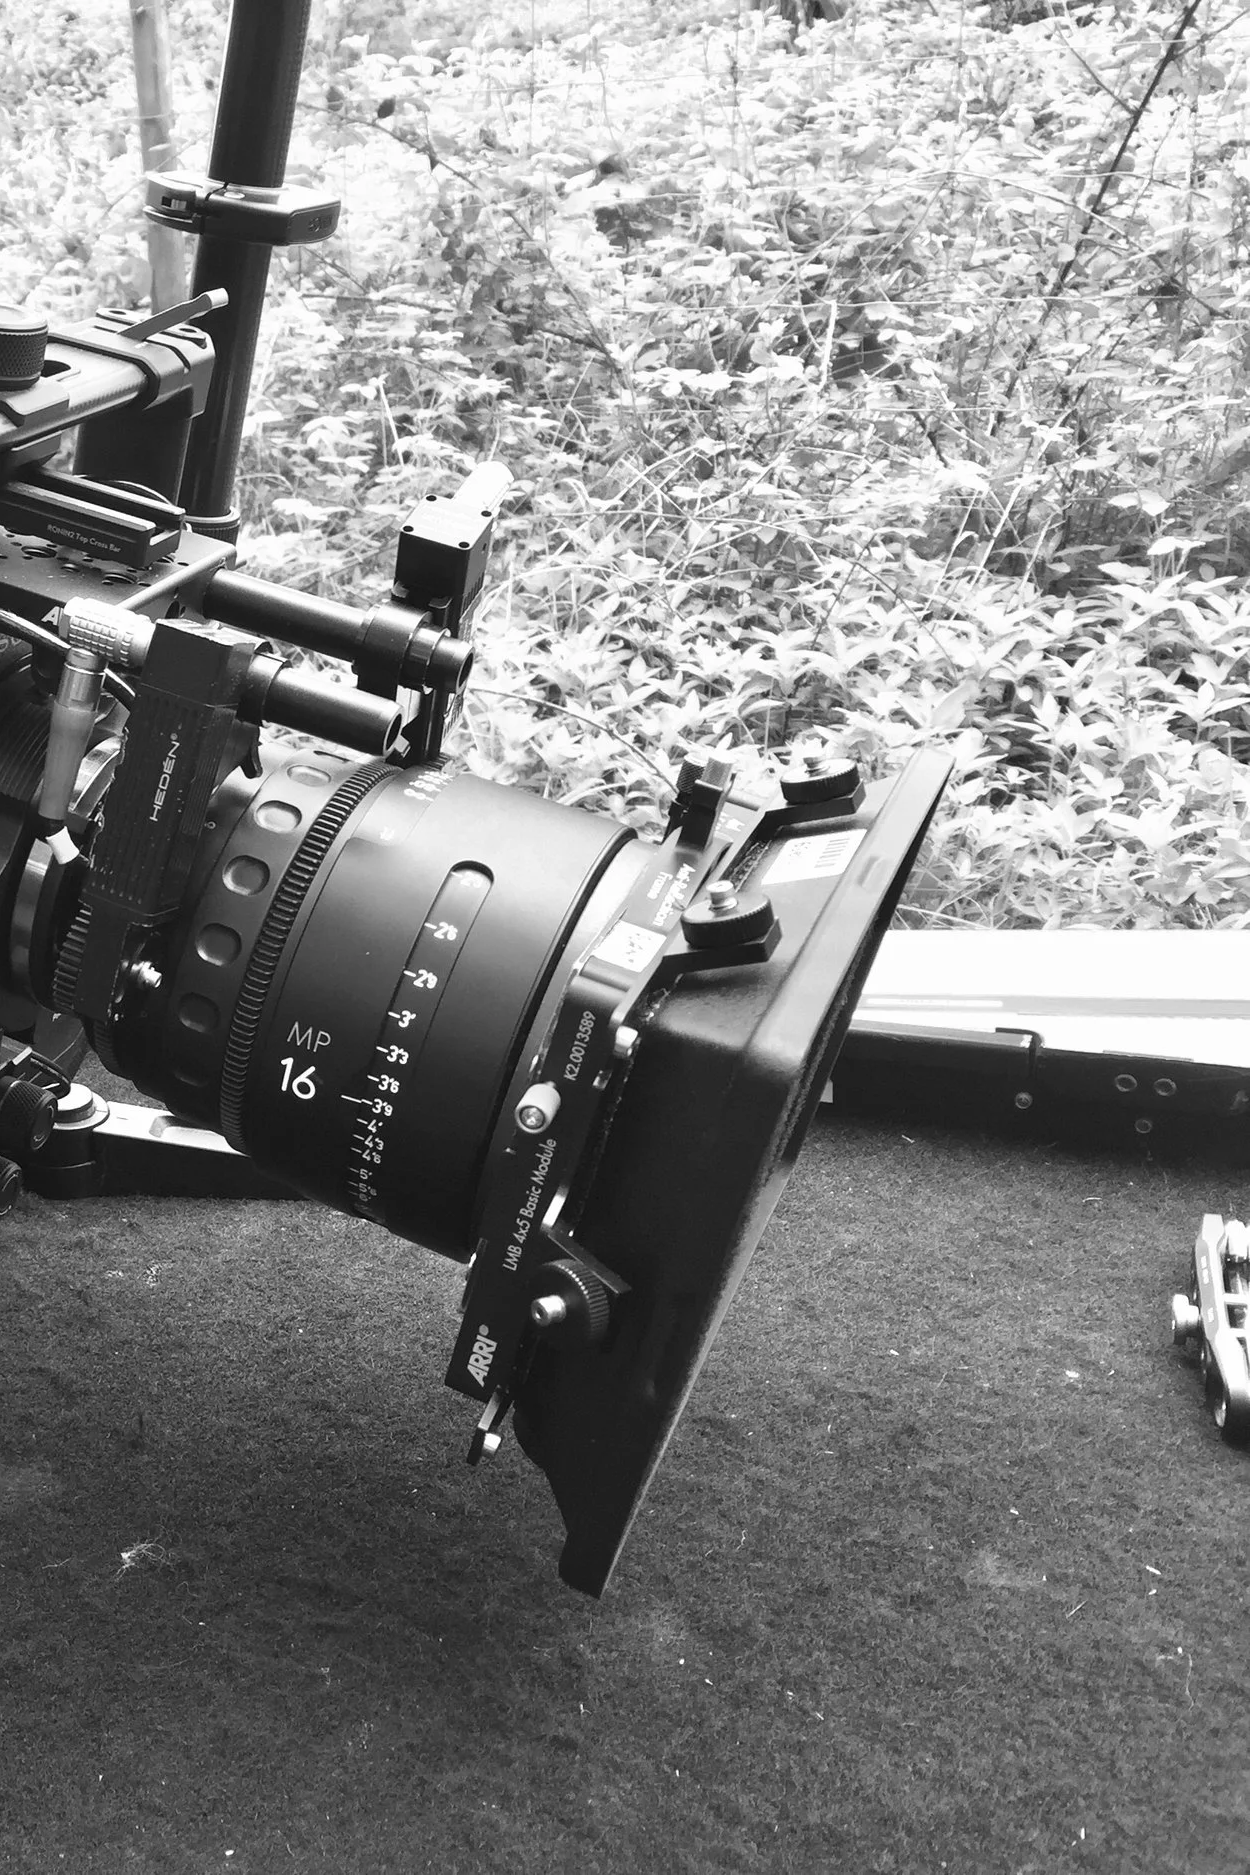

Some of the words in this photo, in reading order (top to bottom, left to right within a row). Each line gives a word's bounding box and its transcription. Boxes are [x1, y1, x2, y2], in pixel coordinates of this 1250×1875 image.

[287, 1021, 332, 1053] MP
[563, 1010, 596, 1081] K2.0013589
[280, 1057, 316, 1100] 16
[530, 1138, 557, 1185] Module
[519, 1186, 542, 1219] Basic
[512, 1217, 531, 1244] 4x5
[502, 1244, 523, 1272] LMB
[467, 1334, 498, 1388] ARRI
